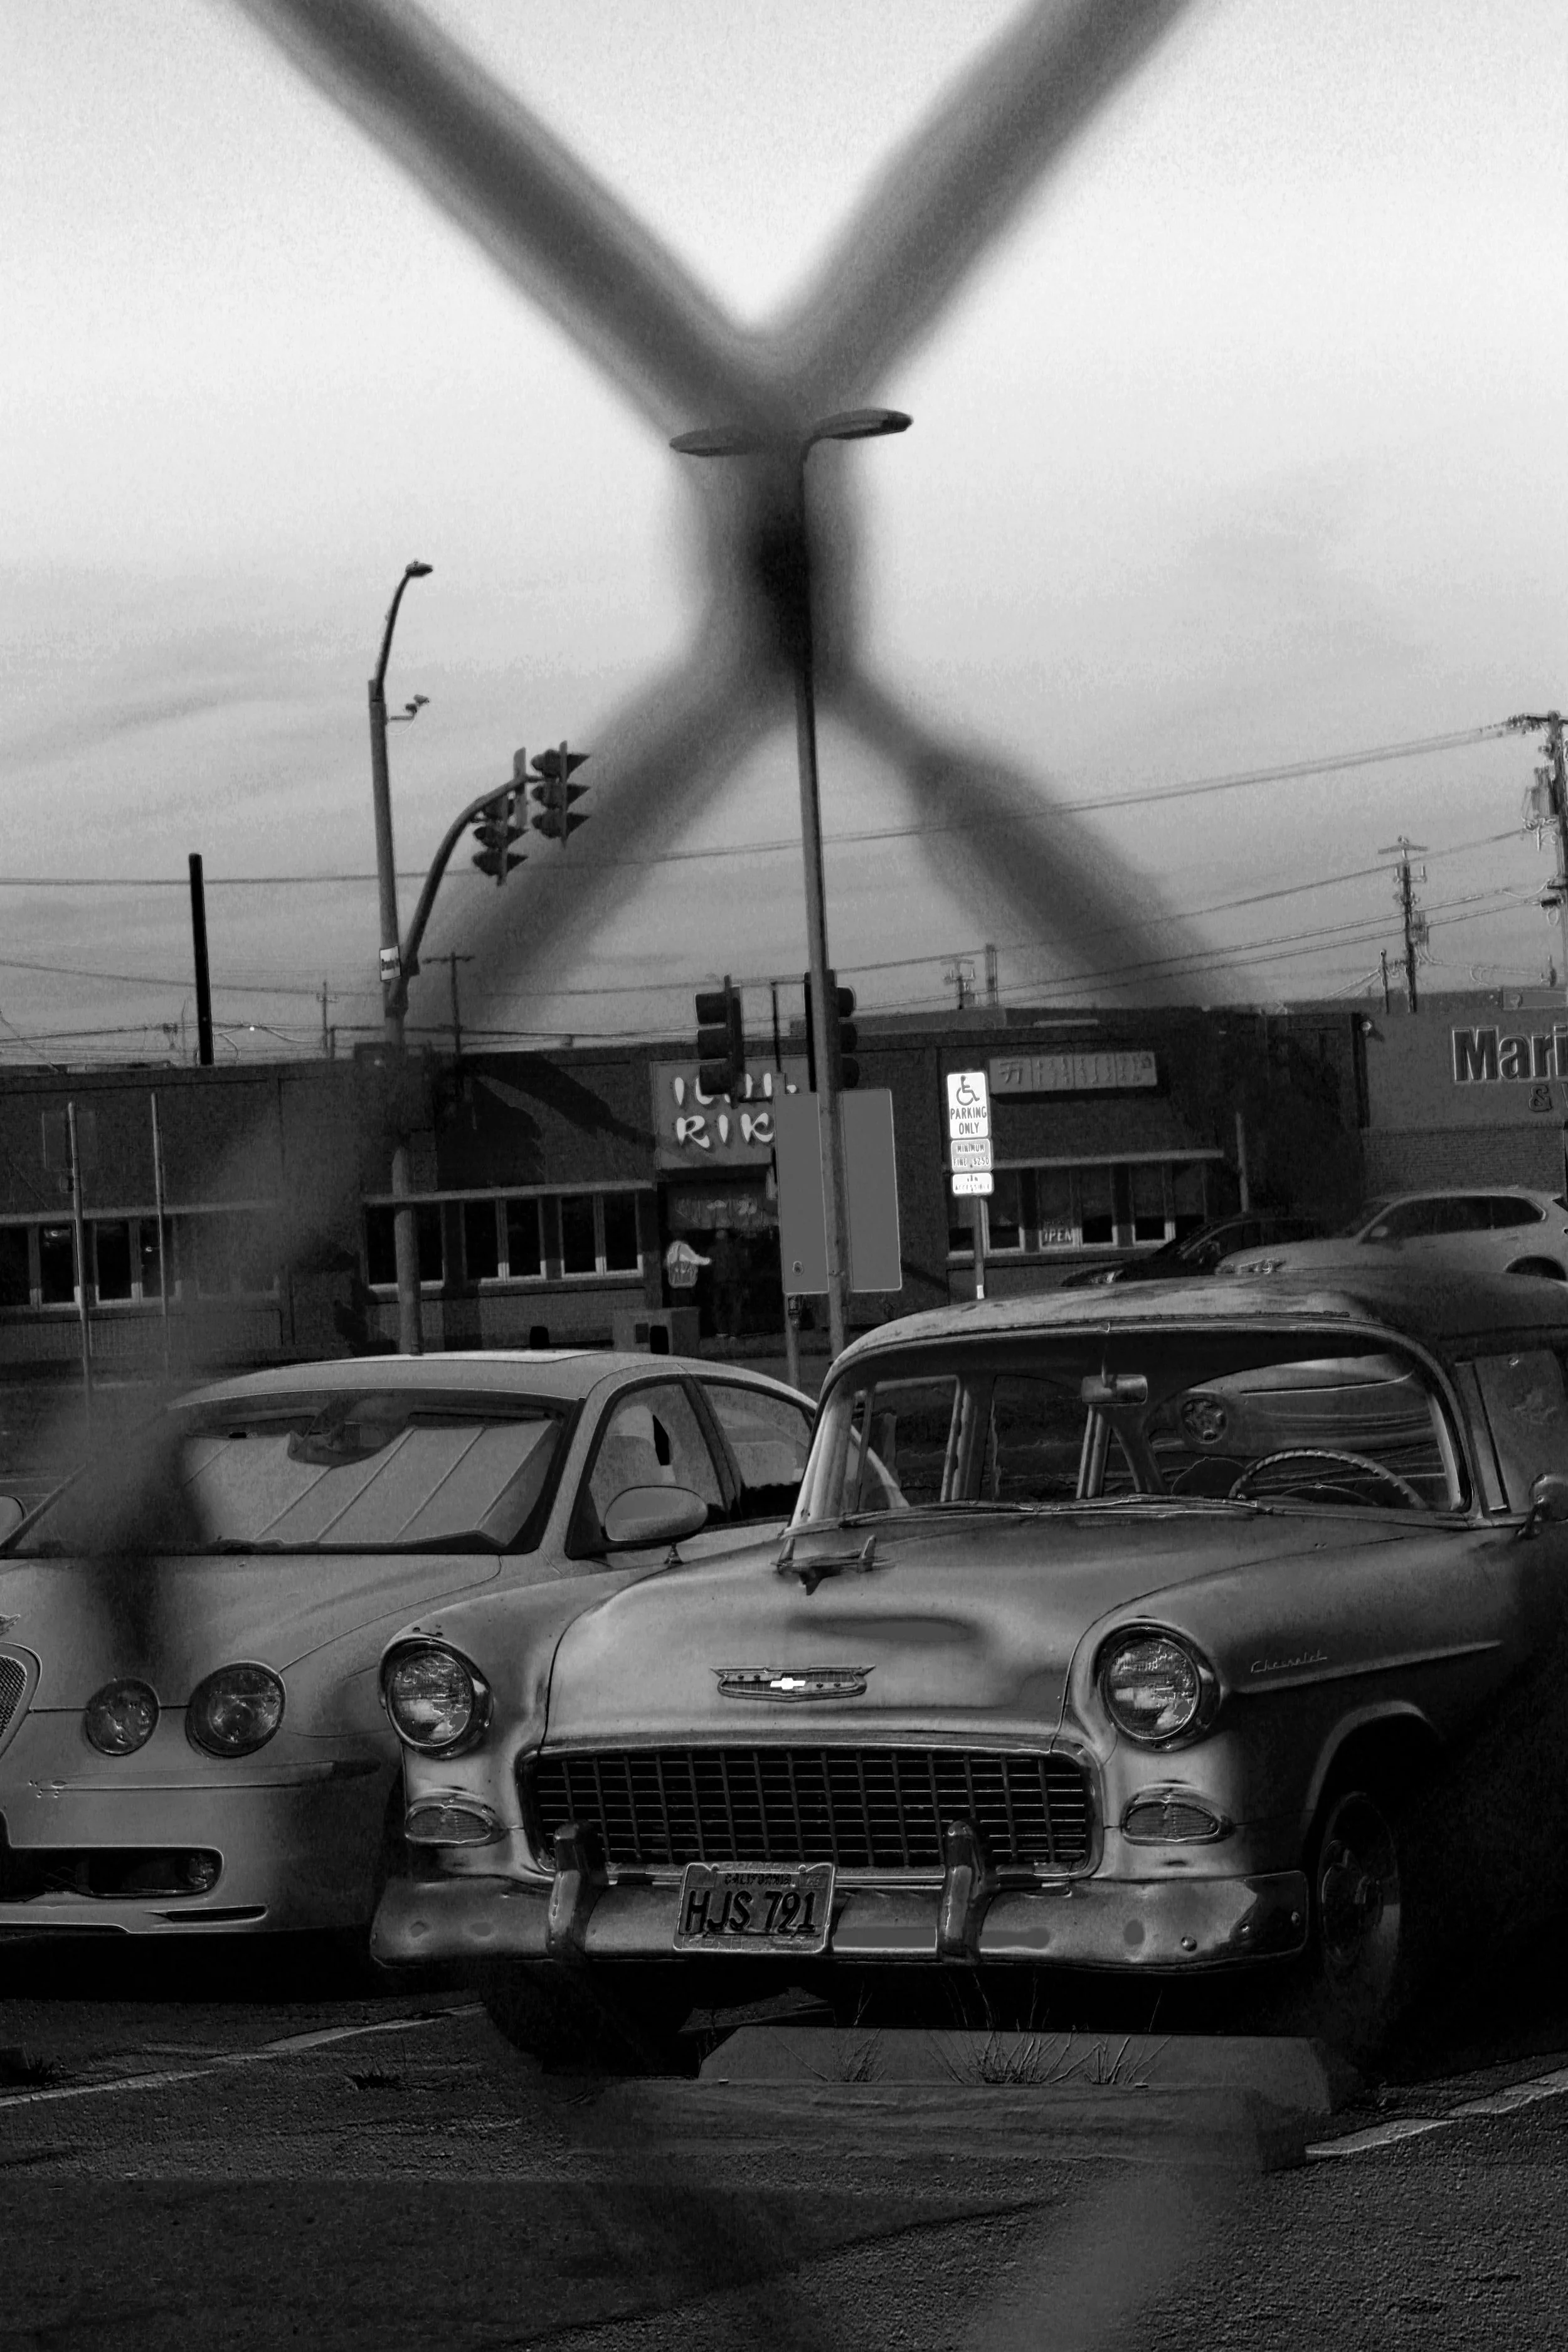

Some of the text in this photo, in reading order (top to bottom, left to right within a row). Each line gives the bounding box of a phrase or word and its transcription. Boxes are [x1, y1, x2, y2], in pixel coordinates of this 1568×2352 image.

[1453, 1025, 1568, 1081] Mari
[1528, 1084, 1552, 1112] &
[950, 1106, 987, 1120] PARKING
[959, 1121, 979, 1135] ONLY
[957, 1143, 984, 1152] MINIMUM
[953, 1157, 990, 1167] FINE $250
[725, 1873, 792, 1885] CALIFORNIA
[686, 1890, 815, 1933] HJS 791
